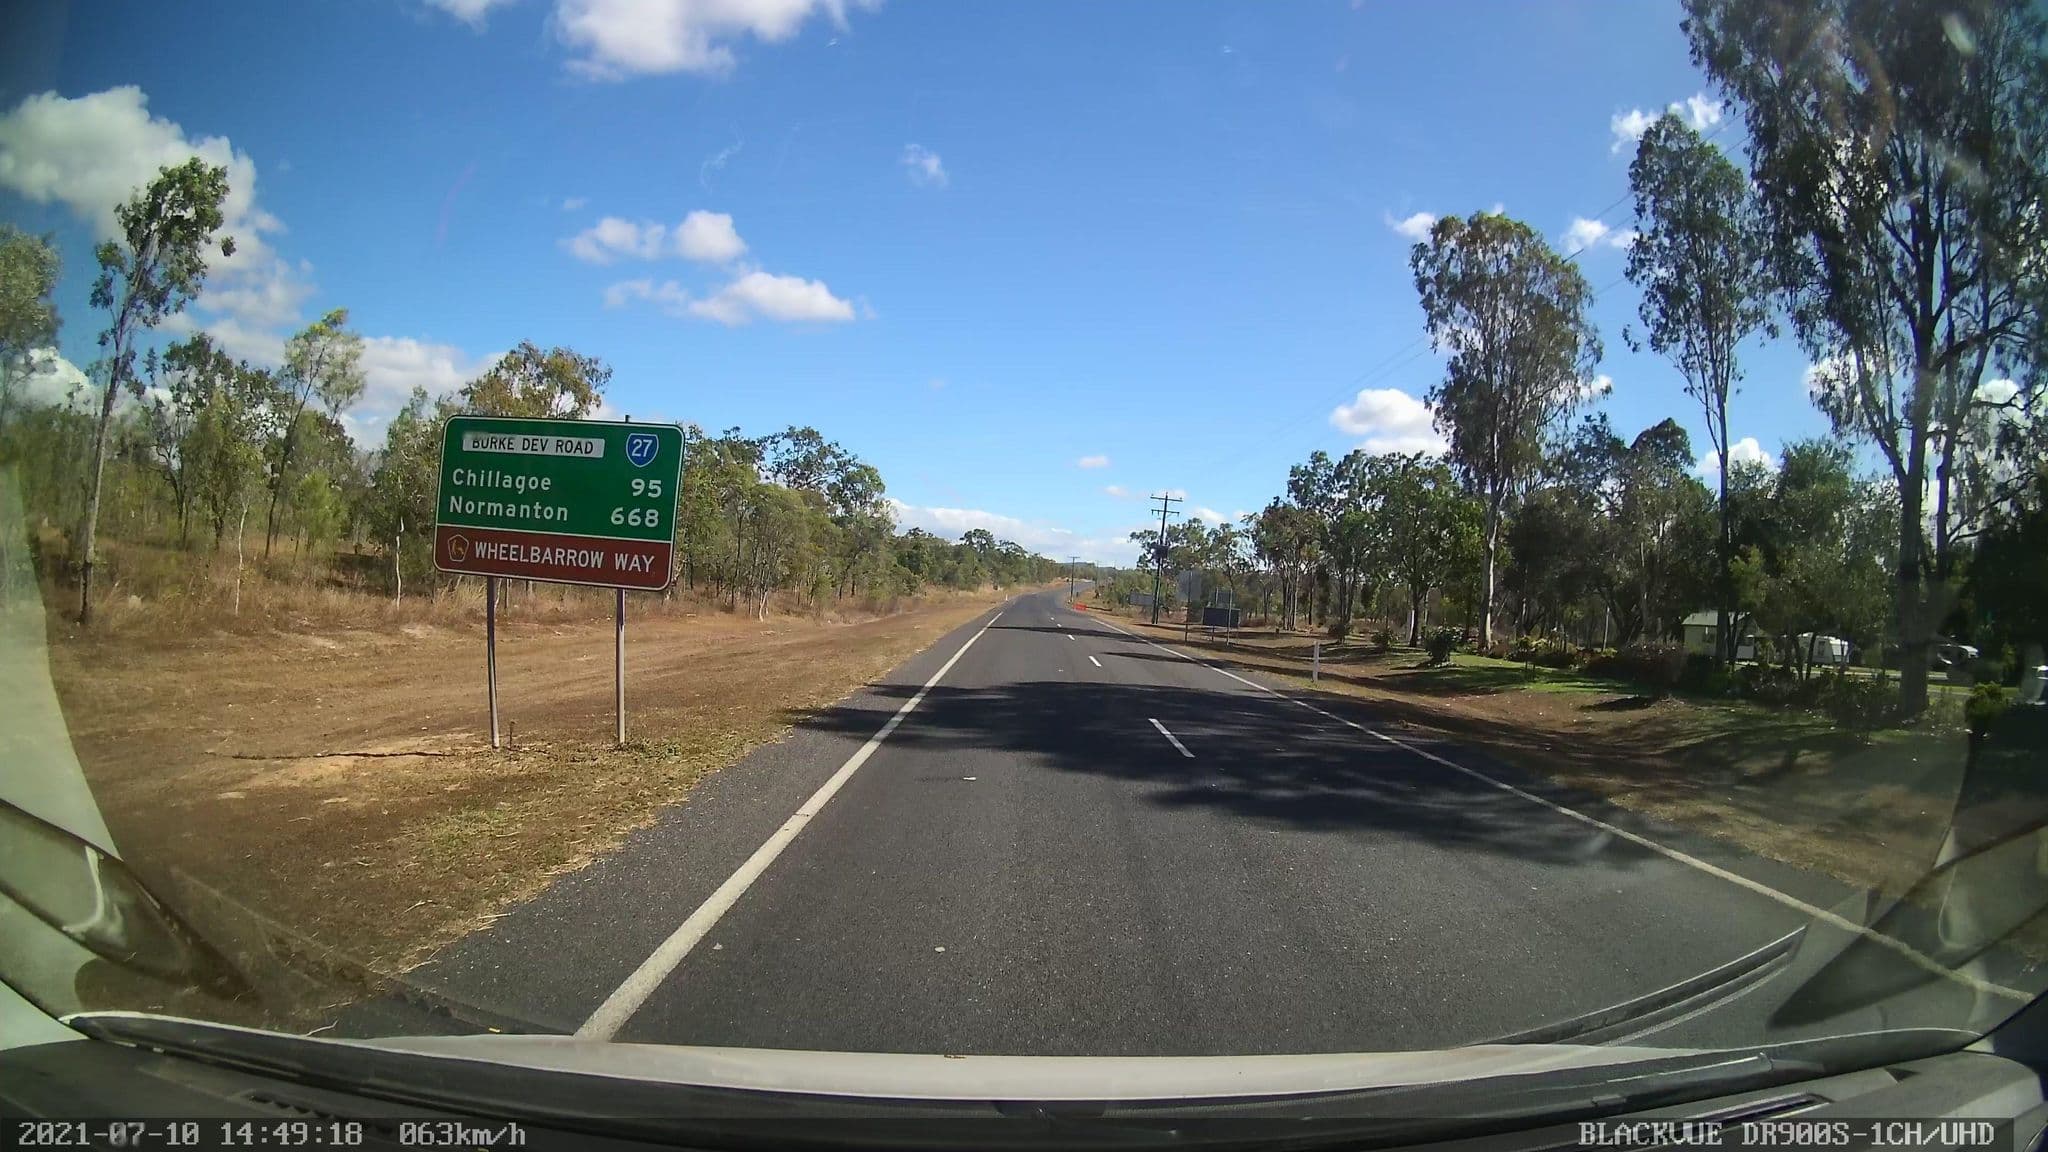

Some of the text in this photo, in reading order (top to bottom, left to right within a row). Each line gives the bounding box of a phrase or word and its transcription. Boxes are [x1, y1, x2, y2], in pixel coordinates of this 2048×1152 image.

[472, 438, 594, 455] BURKE DEV ROAD
[632, 438, 652, 458] 27
[452, 468, 552, 495] Chillagoe
[631, 478, 662, 498] 95
[449, 495, 569, 522] Normanton
[610, 506, 660, 528] 668
[475, 541, 656, 574] WHEELBARROW WAY
